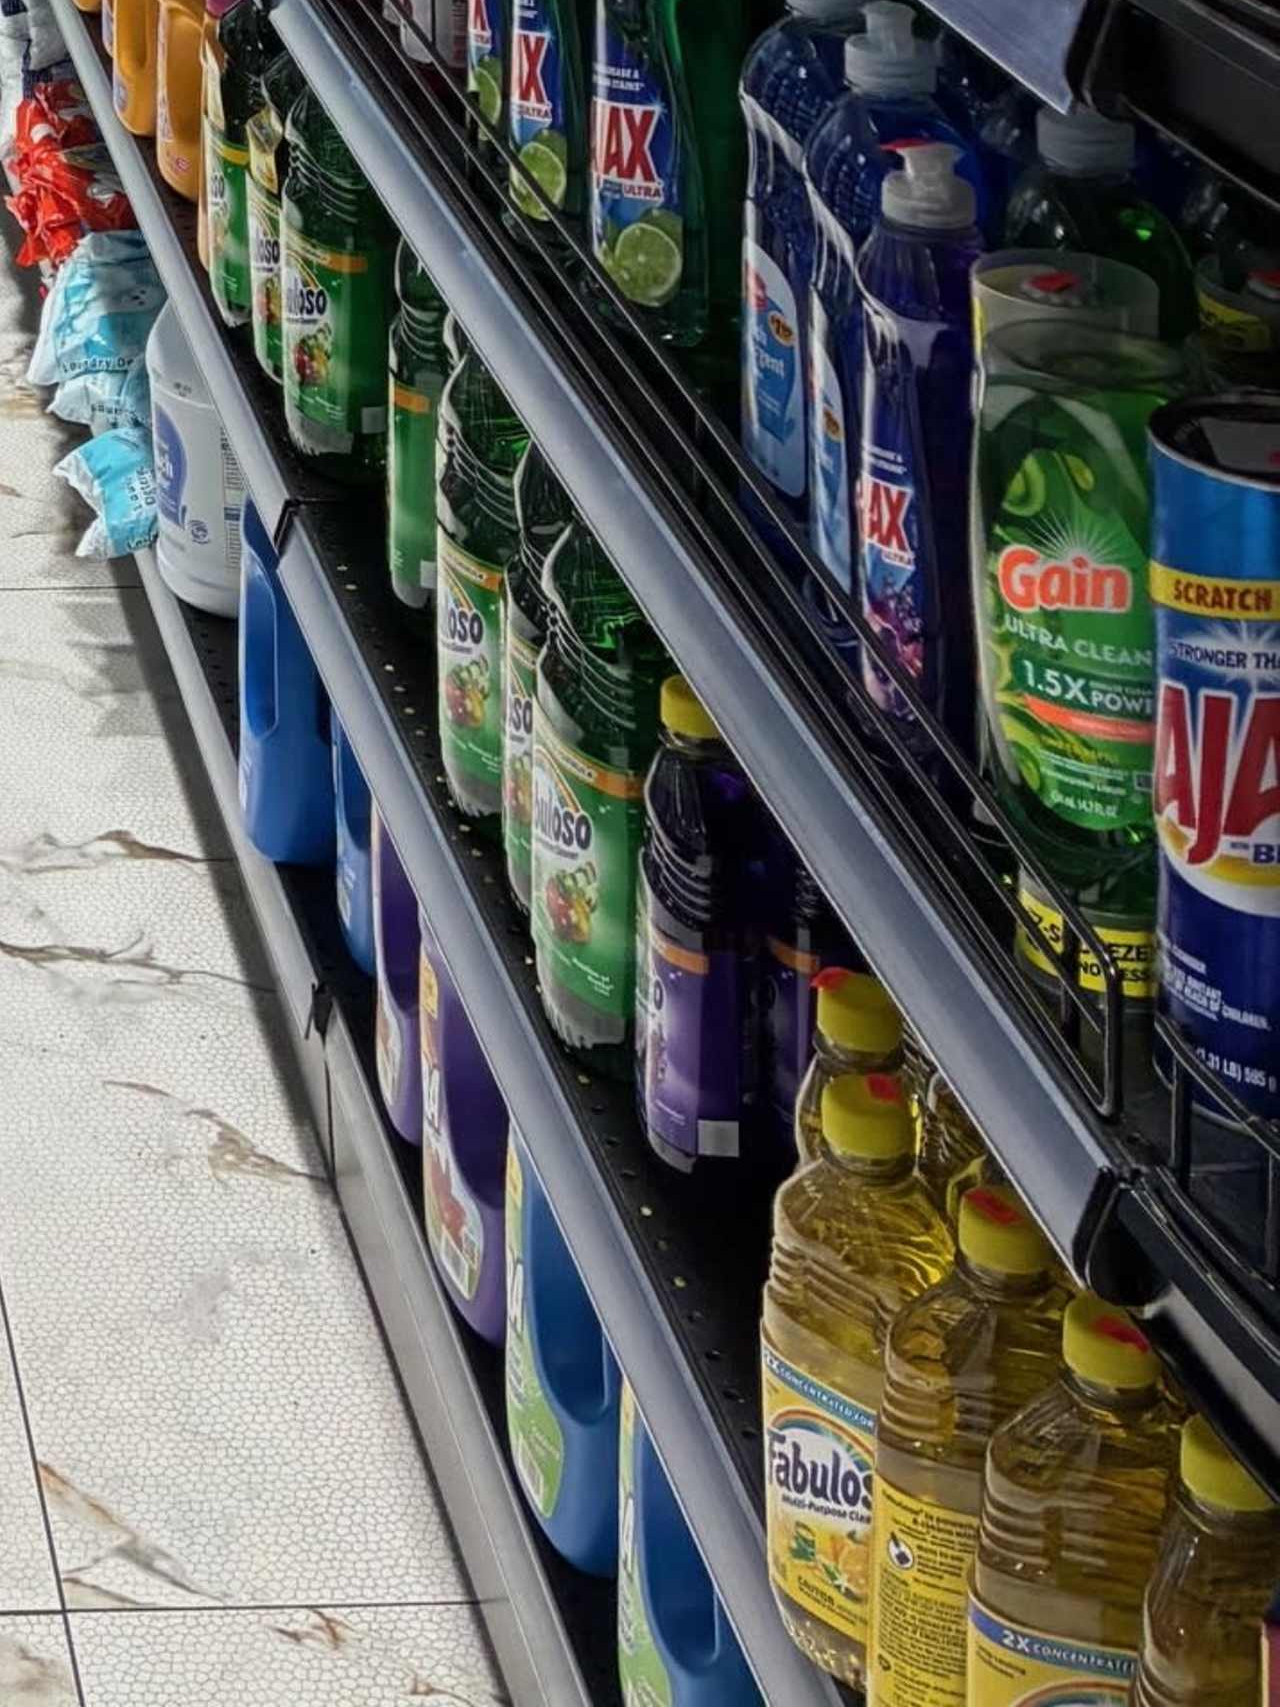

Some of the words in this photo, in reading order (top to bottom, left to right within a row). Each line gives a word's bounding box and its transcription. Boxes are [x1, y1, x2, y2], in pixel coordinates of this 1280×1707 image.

[997, 544, 1133, 615] Gain
[1173, 578, 1271, 611] SCRATCH
[1004, 612, 1070, 654] ULTRA
[1074, 637, 1154, 667] CLEAN
[1169, 640, 1248, 669] STRONGER
[1022, 659, 1092, 708] 1.5X
[1002, 1628, 1032, 1653] 2X
